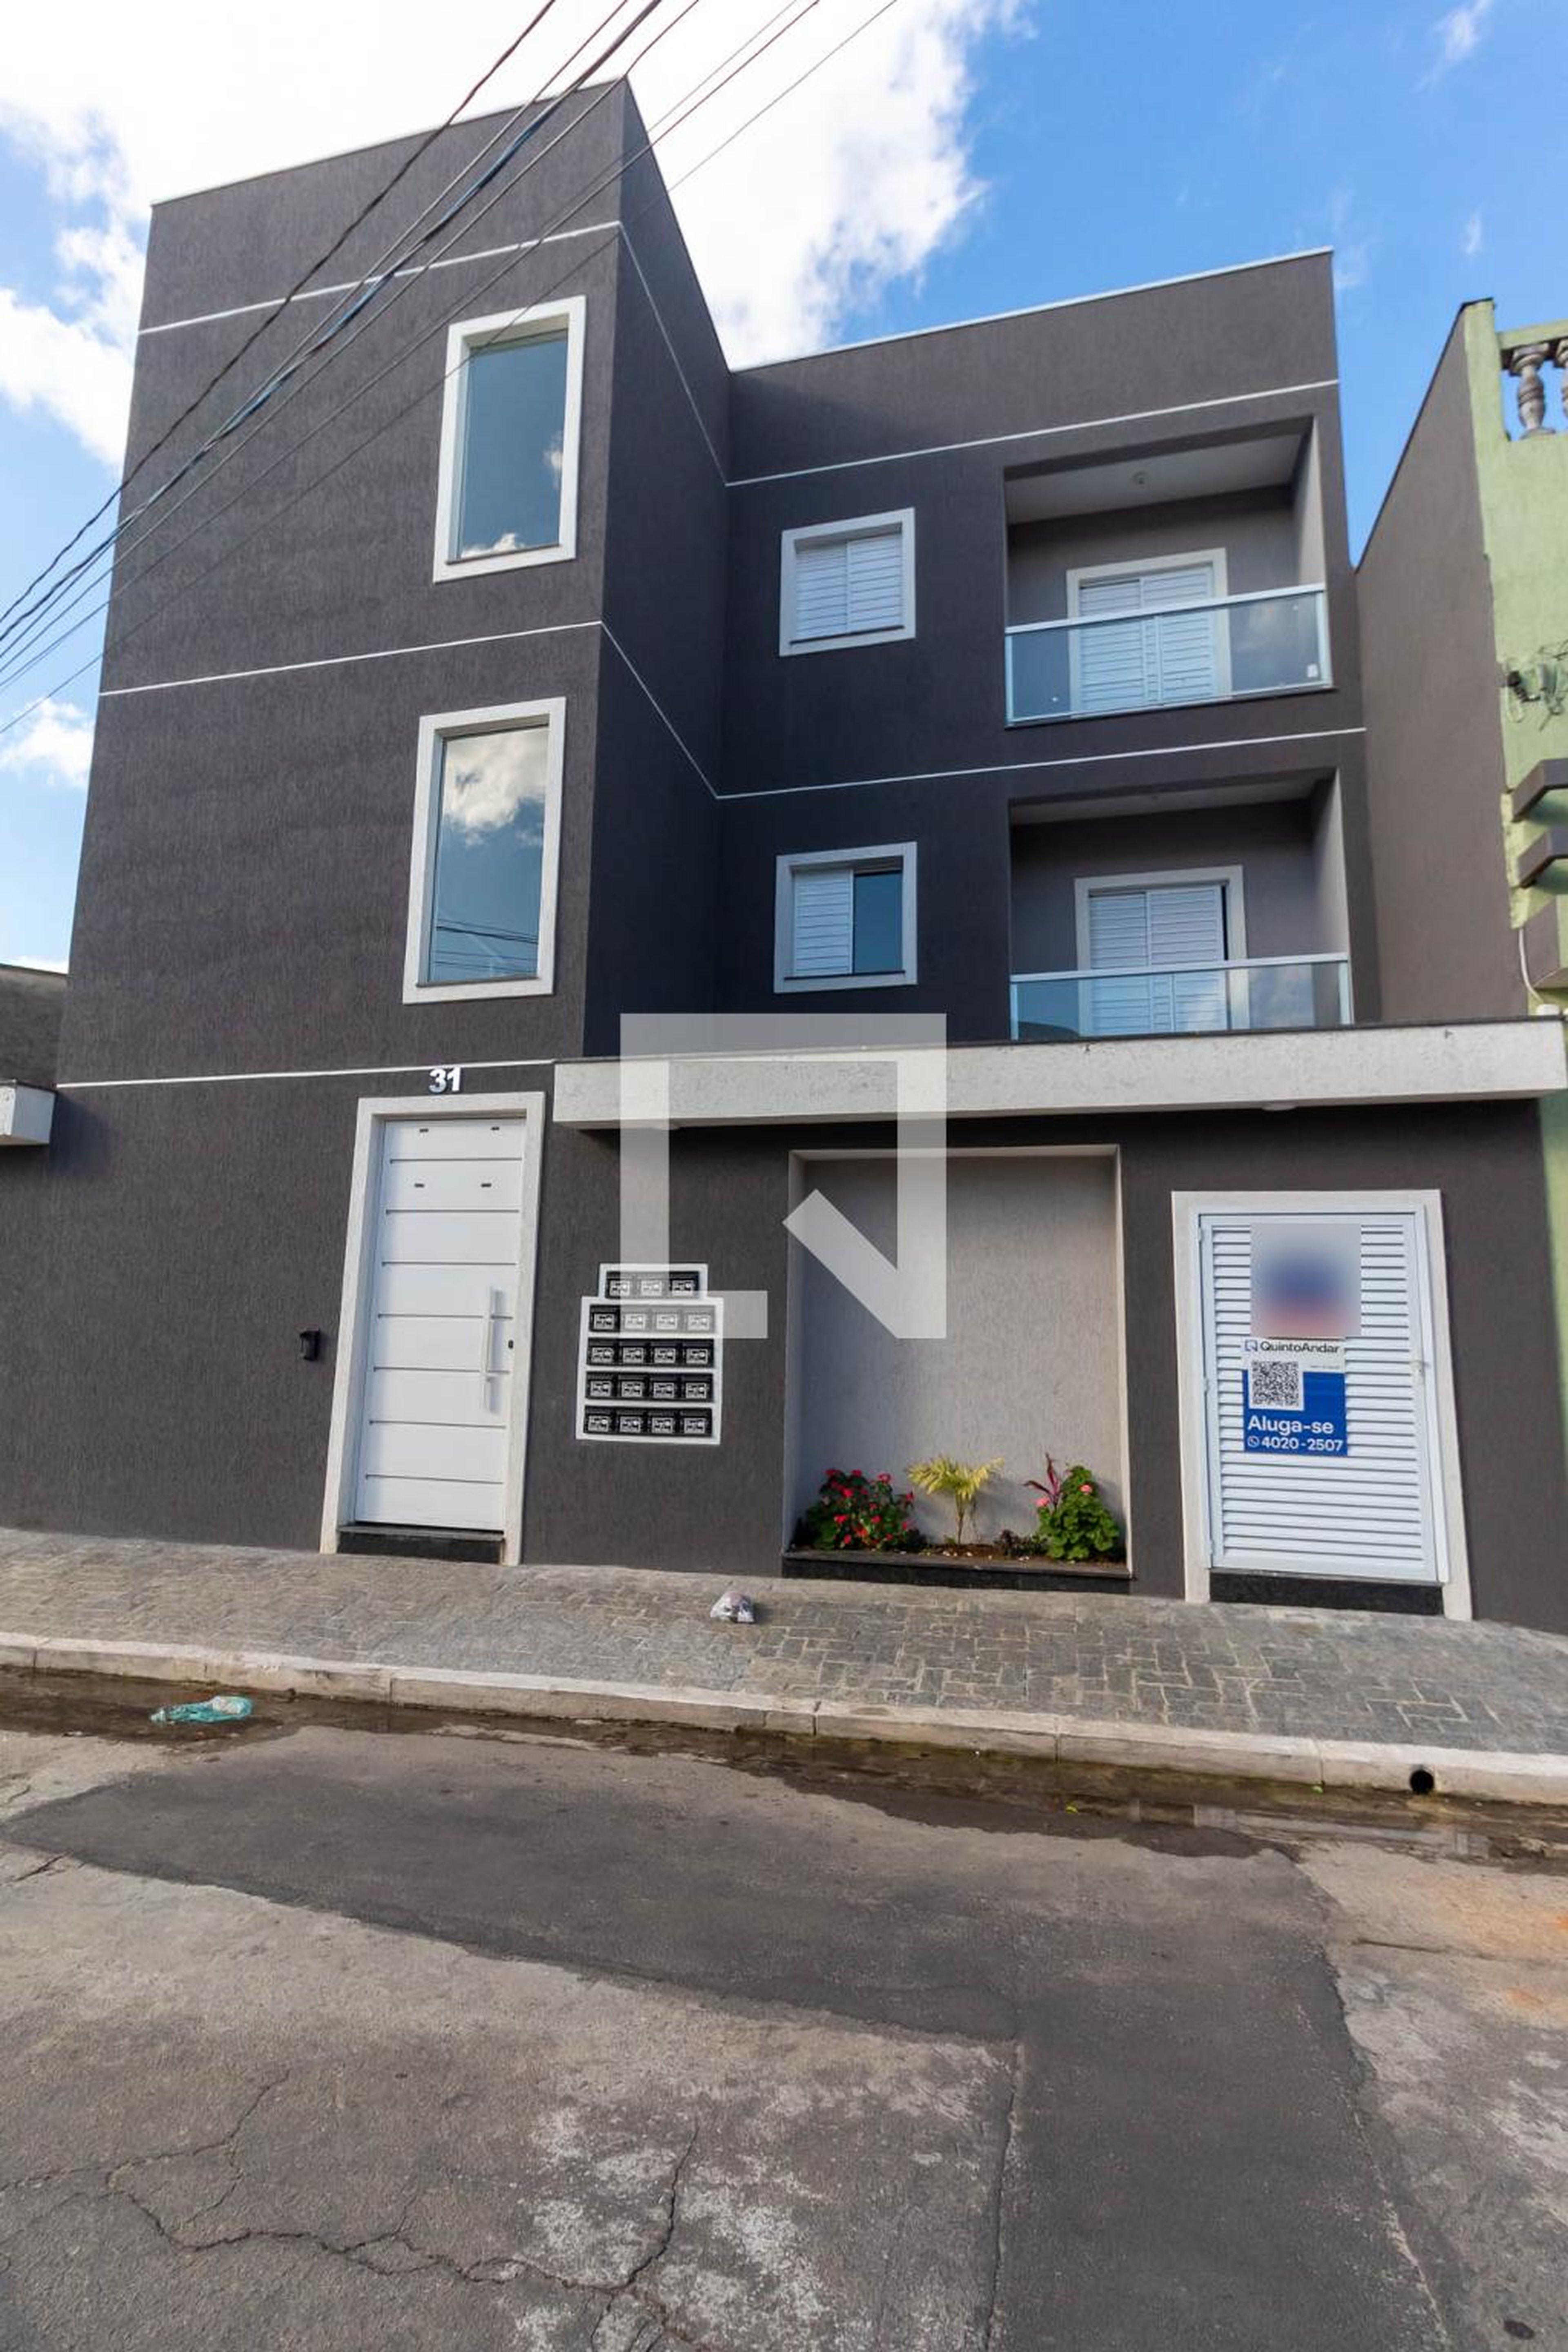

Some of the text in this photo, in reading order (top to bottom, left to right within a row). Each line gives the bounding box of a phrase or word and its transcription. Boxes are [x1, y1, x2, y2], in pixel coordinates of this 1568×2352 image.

[429, 1067, 461, 1093] 31
[1261, 1341, 1340, 1353] QuintoAndar
[1248, 1415, 1334, 1436] Aluga-se
